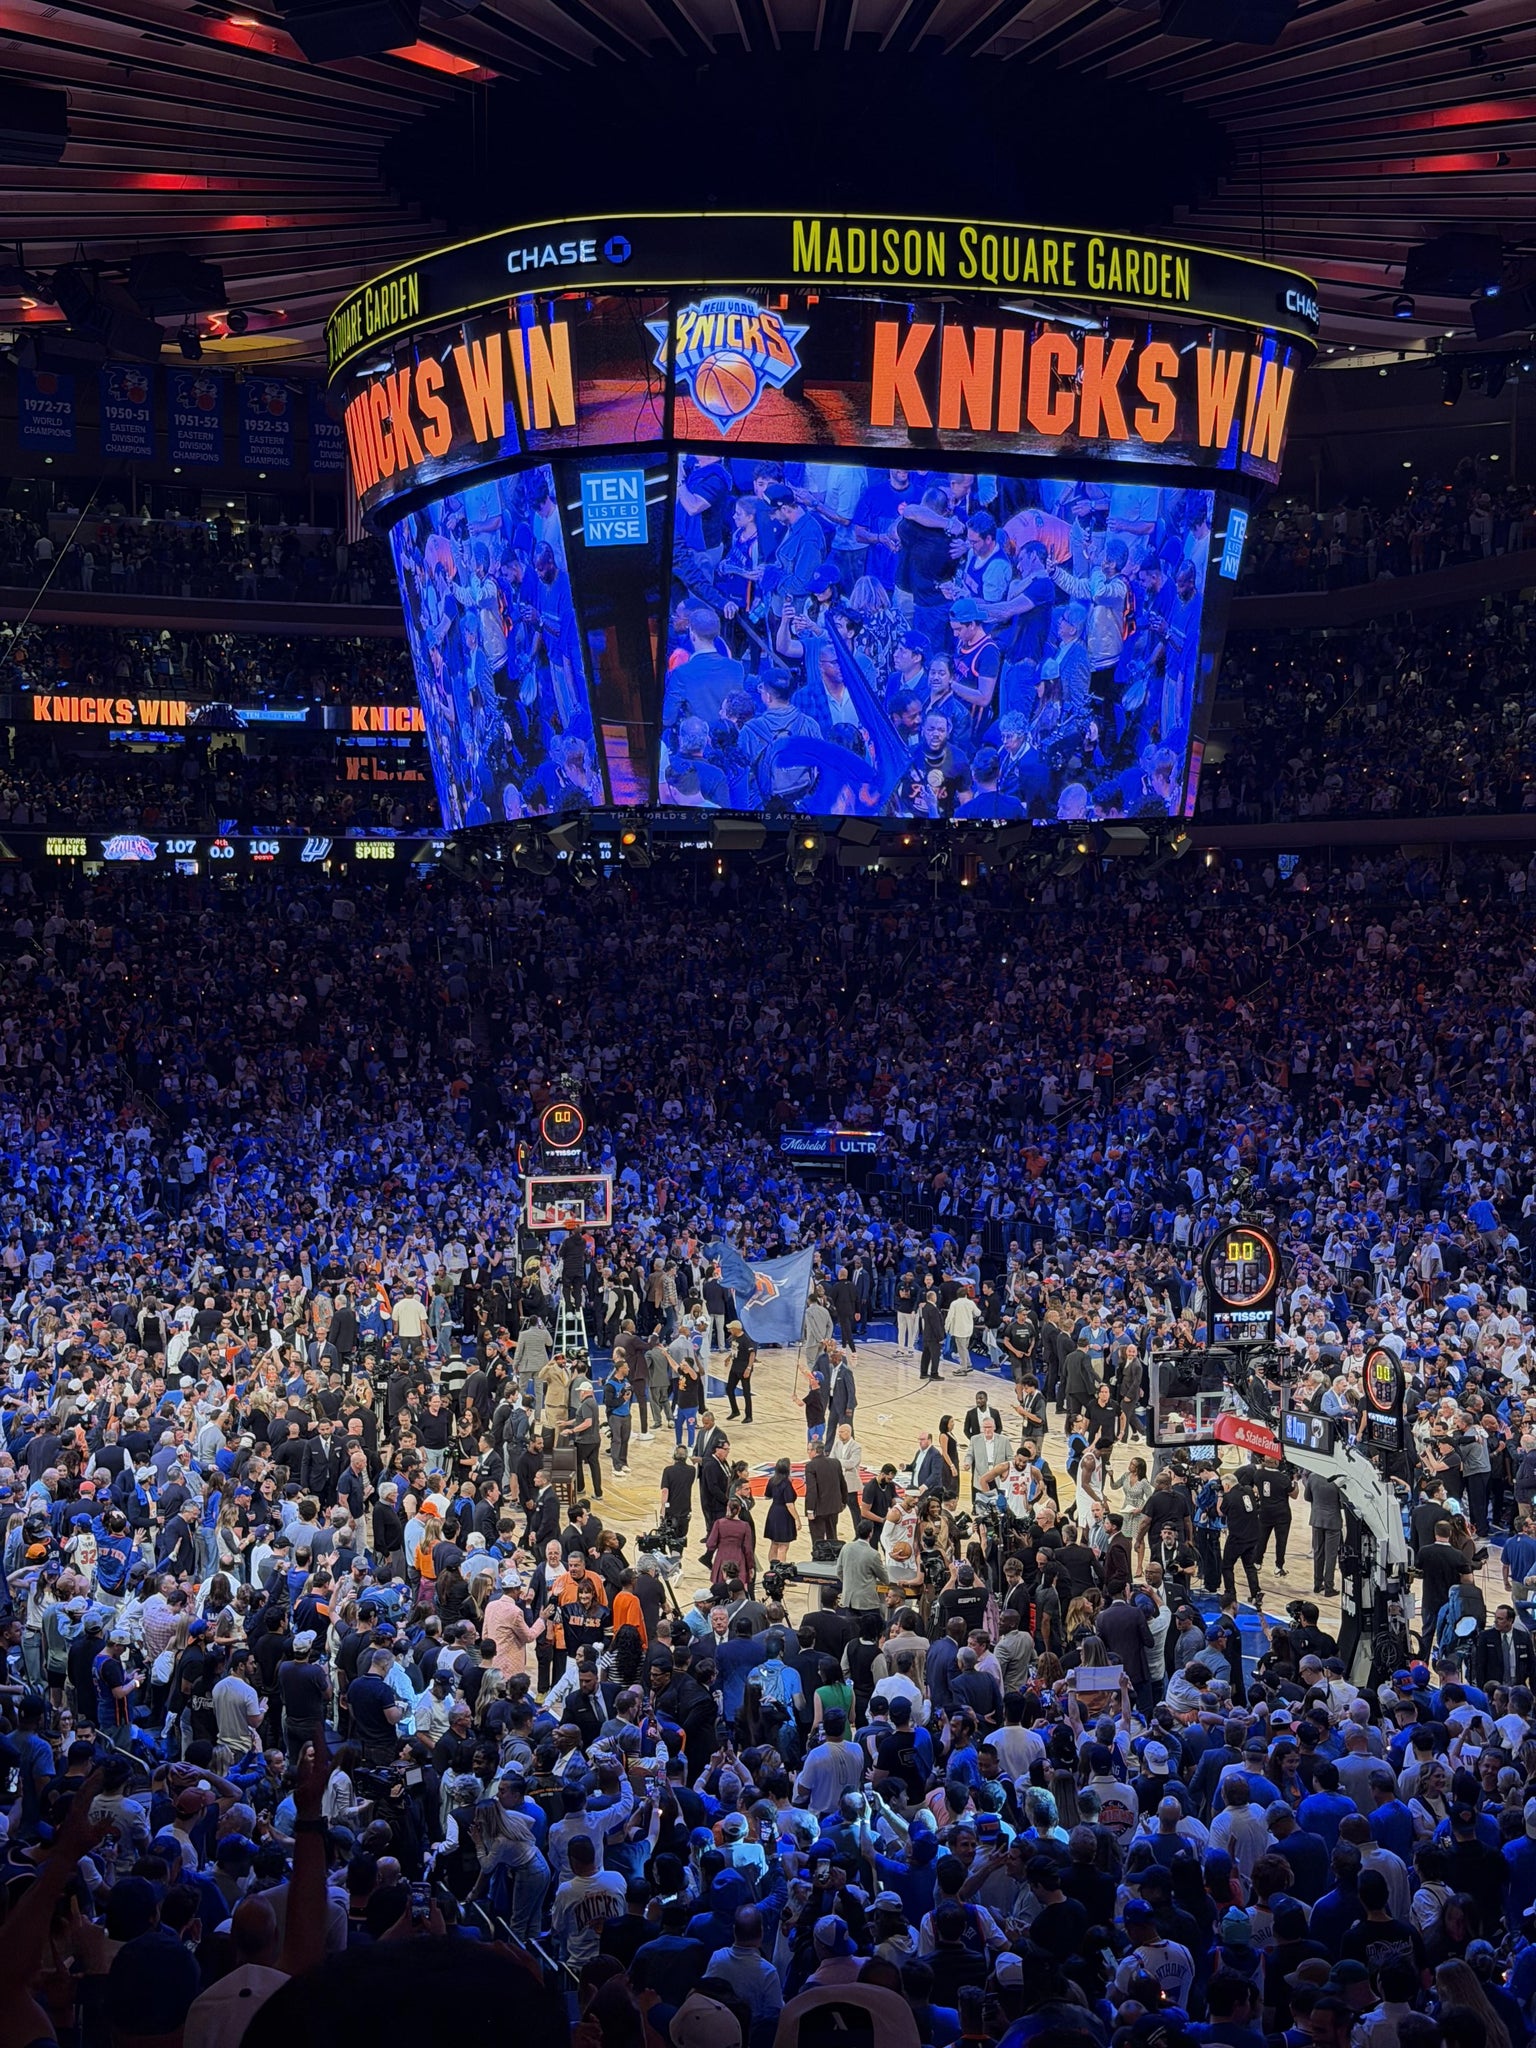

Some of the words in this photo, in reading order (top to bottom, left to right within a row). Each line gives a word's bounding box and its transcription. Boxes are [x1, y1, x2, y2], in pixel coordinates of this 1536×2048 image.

[507, 240, 598, 273] CHASE
[791, 219, 946, 278] MADISON
[958, 226, 1076, 287] SQUARE
[1087, 237, 1191, 301] GARDEN
[365, 272, 419, 336] GARDEN
[702, 301, 726, 314] NEW
[728, 301, 755, 316] YORK
[659, 311, 795, 368] KNICKS
[453, 321, 576, 444] WIN
[869, 320, 1180, 444] KNICKS
[1196, 345, 1295, 463] WIN
[24, 398, 72, 414] 1972-73
[105, 406, 150, 421] 1950-51
[32, 416, 63, 427] WORLD
[109, 422, 146, 433] EASTERN
[174, 414, 219, 429] 1951-52
[244, 419, 290, 433] 1952-53
[23, 426, 72, 438] CHAMPIONS
[177, 431, 214, 441] EASTERN
[314, 423, 344, 437] 1970-
[111, 434, 145, 444] DIVISION
[179, 440, 213, 451] DIVISION
[248, 435, 285, 445] EASTERN
[318, 440, 343, 449] ATLAN
[105, 444, 152, 455] CHAMPIONS
[250, 446, 284, 455] DIVISION
[172, 451, 220, 462] CHAMPIONS
[244, 456, 290, 466] CHAMPIONS
[586, 477, 638, 502] TEN
[588, 505, 639, 518] LISTED
[588, 520, 641, 540] NYSE
[33, 695, 134, 724] KNICKS
[138, 699, 187, 727] WIN
[351, 705, 426, 732] KNICK
[65, 837, 87, 845] YORK
[166, 840, 197, 854] 107
[214, 839, 229, 847] 4th
[46, 844, 87, 856] KNICKS
[210, 846, 234, 859] 0.0
[250, 841, 280, 855] 106
[355, 846, 395, 859] SPURS
[555, 1111, 571, 1123] 0.0
[780, 1137, 827, 1151] Michelob
[840, 1141, 877, 1153] ULTR
[555, 1149, 581, 1157] TISSOT
[1228, 1242, 1253, 1261] 0.0
[1230, 1311, 1273, 1322] TISSOT
[1375, 1413, 1397, 1426] TISSOT
[906, 1525, 913, 1538] 3
[80, 1548, 97, 1565] 32
[575, 1895, 620, 1932] KNICKS
